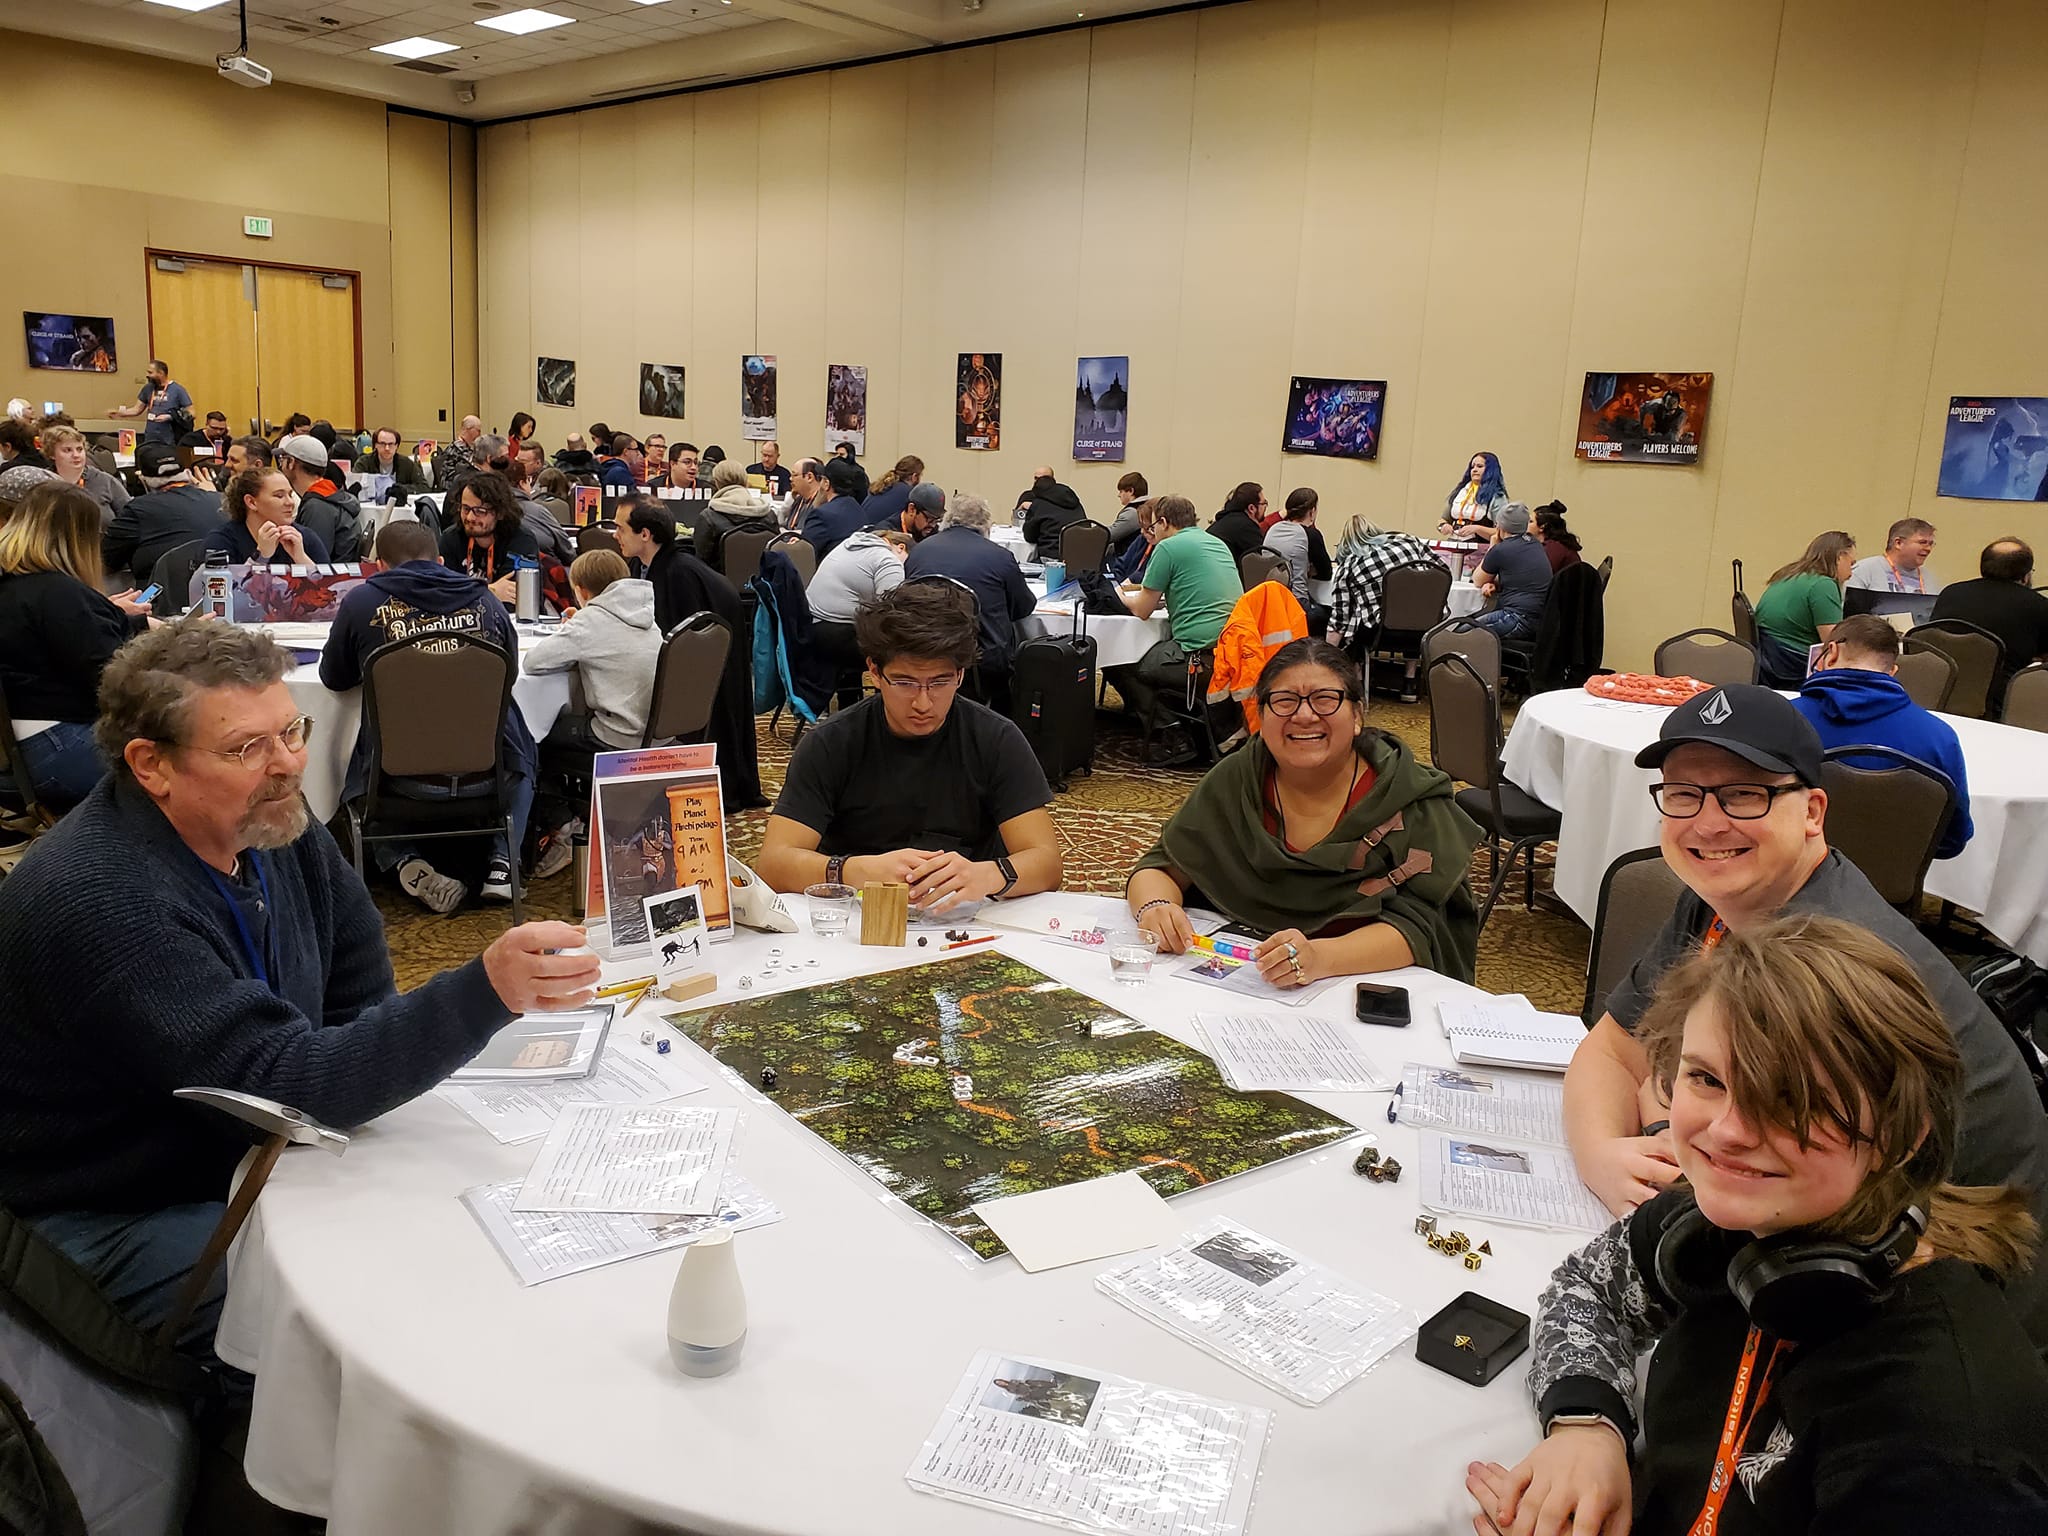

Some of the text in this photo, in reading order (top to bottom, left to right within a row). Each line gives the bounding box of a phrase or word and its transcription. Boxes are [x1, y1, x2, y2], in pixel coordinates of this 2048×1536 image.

[249, 218, 268, 233] EXIT
[1950, 407, 1996, 415] ADVENTURERS
[1959, 414, 1984, 422] LEAGUE
[1578, 442, 1622, 451] ADVENTURERS
[1643, 444, 1698, 454] PLAYERS WELCOME
[1588, 450, 1611, 458] LEAGUE
[376, 605, 405, 625] The
[390, 612, 475, 641] Adventure
[639, 755, 658, 763] Health
[686, 797, 703, 807] Play
[683, 809, 707, 819] Planet
[675, 820, 718, 832] Archipelago
[677, 842, 711, 860] 9 AM
[1723, 1366, 1749, 1445] SaltCON
